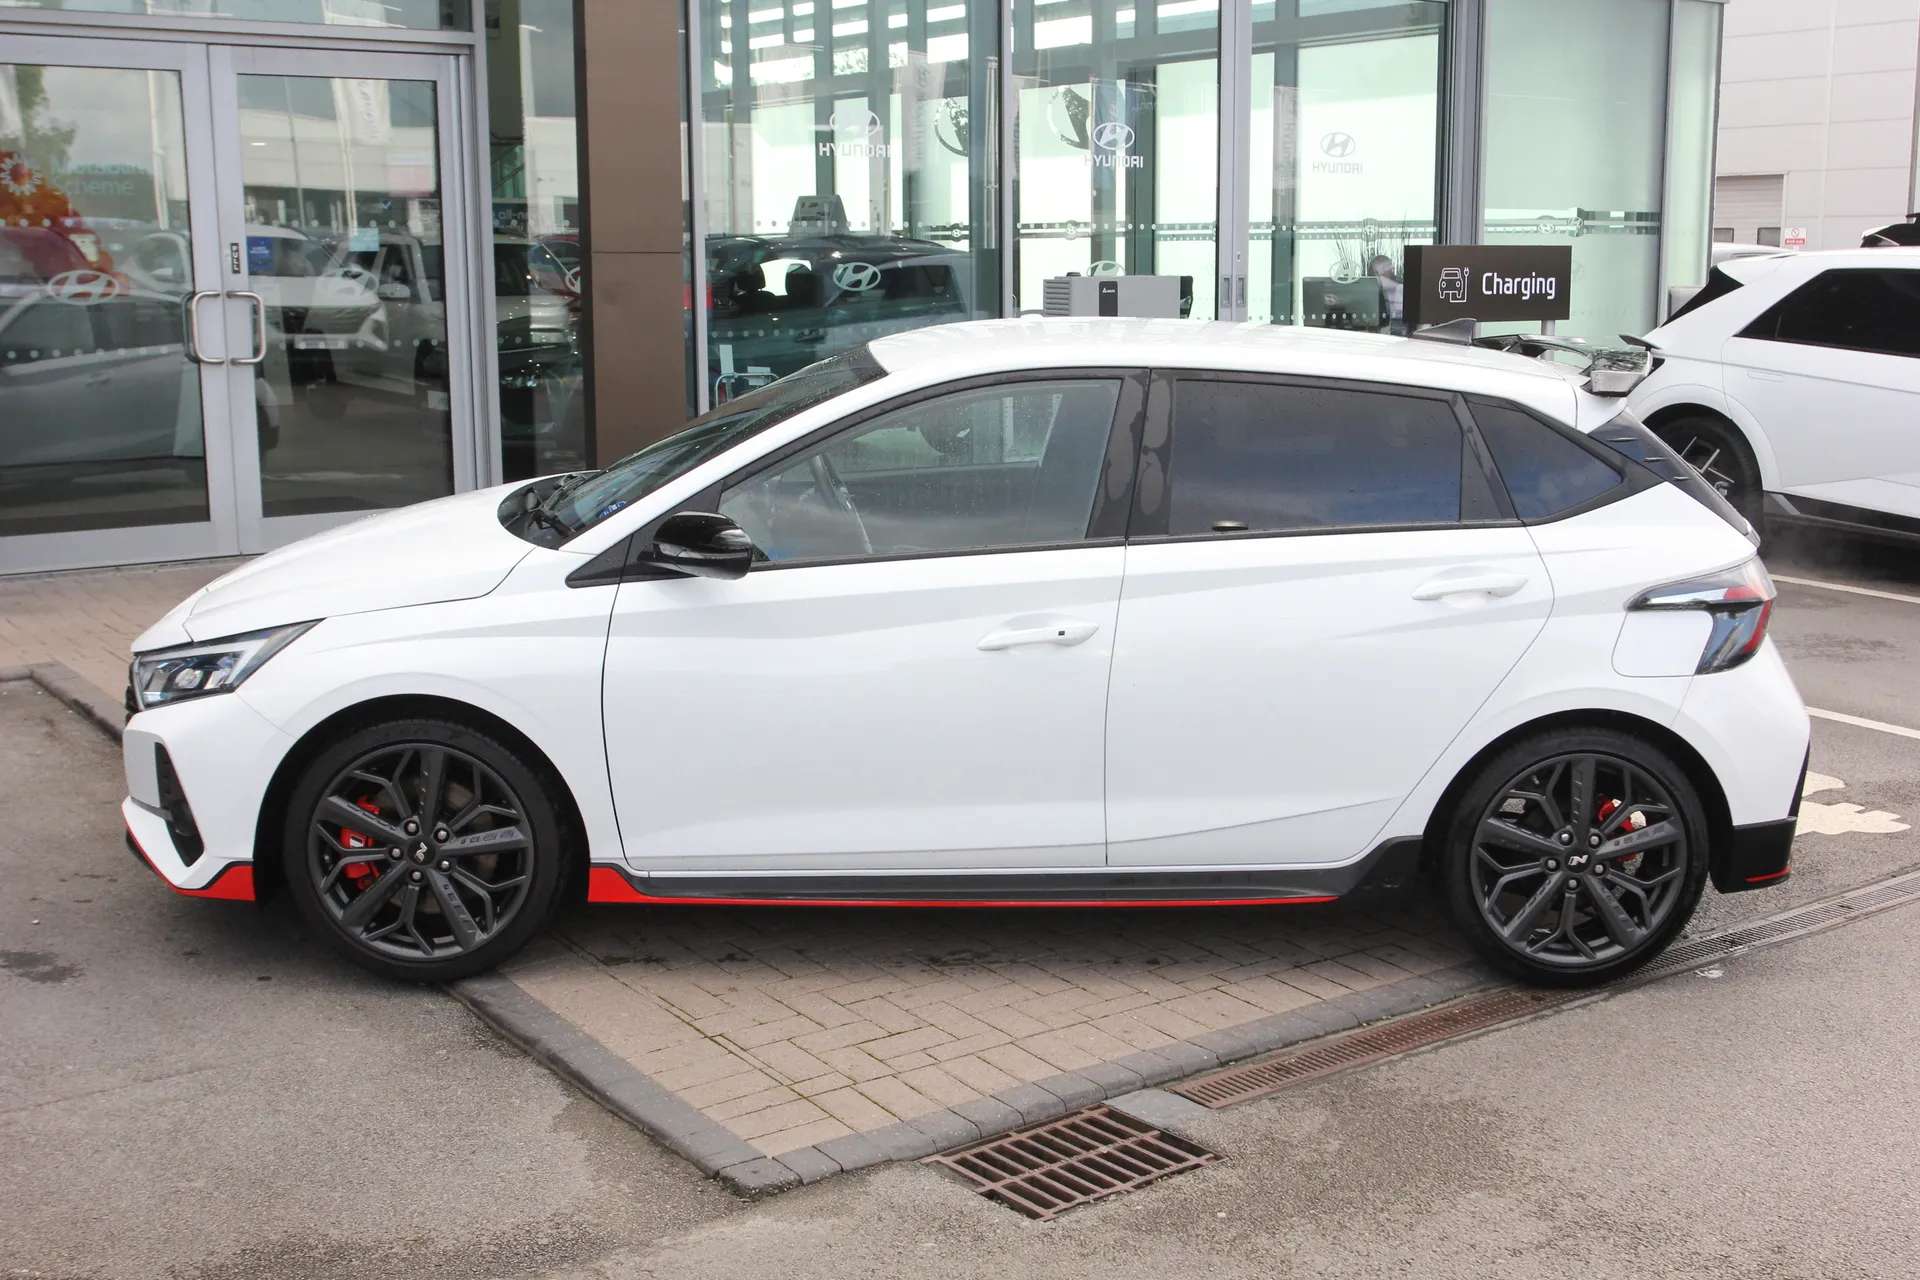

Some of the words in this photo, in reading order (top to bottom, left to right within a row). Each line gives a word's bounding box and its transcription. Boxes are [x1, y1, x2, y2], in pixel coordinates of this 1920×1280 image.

[819, 142, 892, 158] HYUNDAI
[1083, 154, 1144, 169] HYUNDAI
[1312, 160, 1363, 175] HYUNDAI
[1482, 271, 1556, 300] Charging
